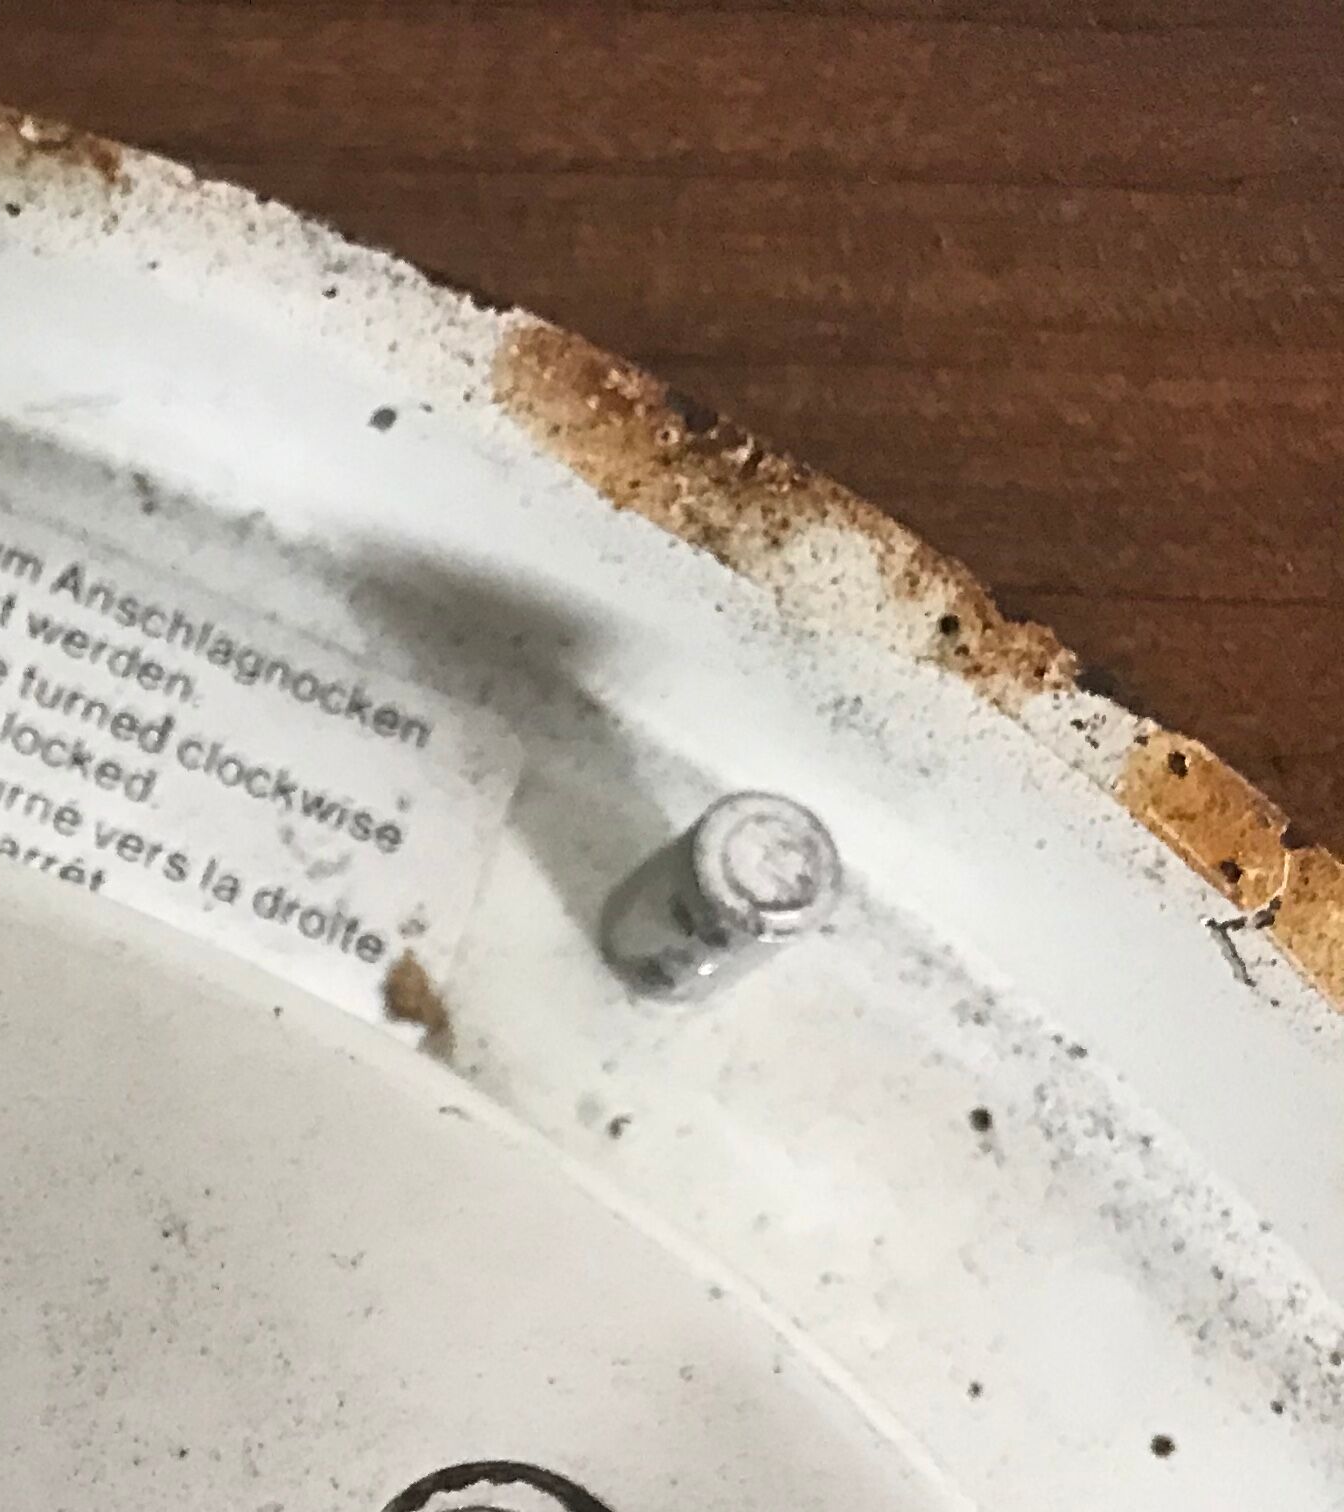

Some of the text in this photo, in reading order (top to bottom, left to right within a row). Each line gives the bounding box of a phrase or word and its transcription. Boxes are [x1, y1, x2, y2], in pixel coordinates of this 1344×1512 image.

[50, 561, 432, 748] Anschlagnocken
[20, 665, 176, 753] turned
[177, 735, 403, 853] clockwise
[95, 821, 190, 882] vers
[201, 857, 240, 905] la
[252, 885, 386, 964] droite
